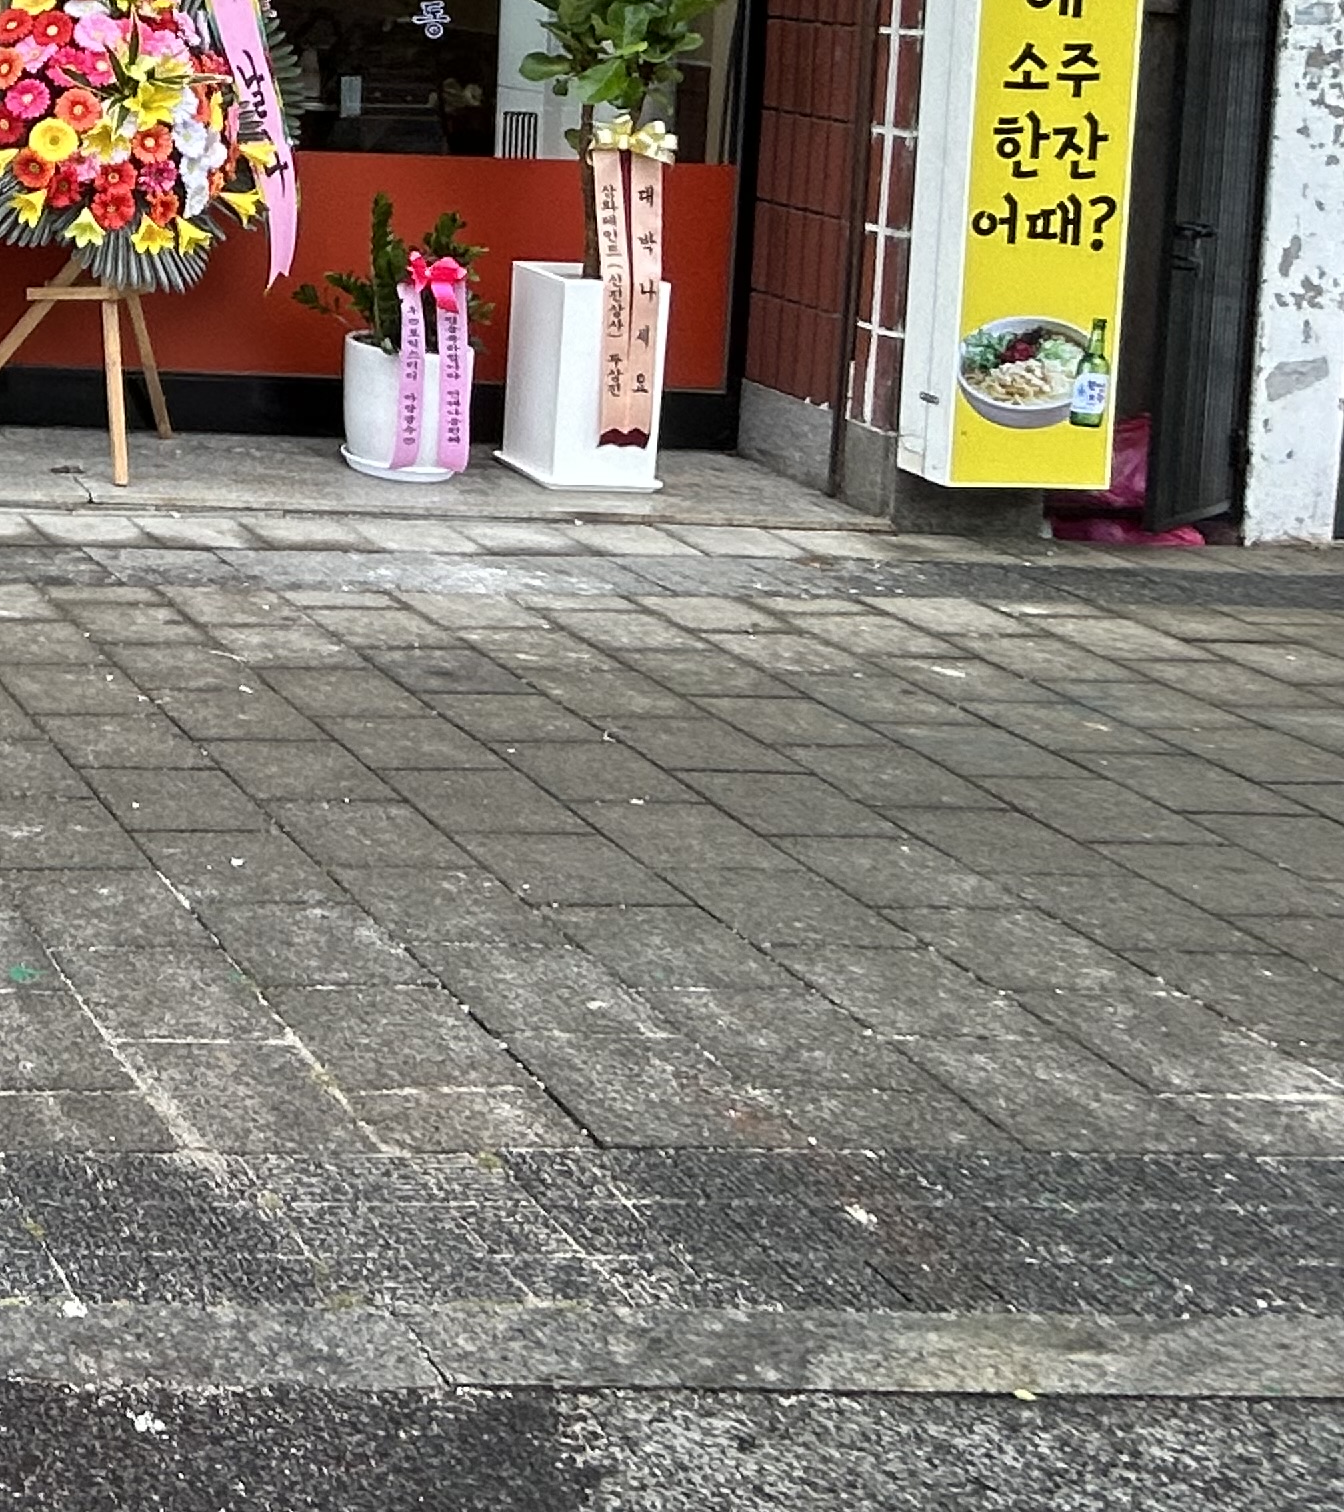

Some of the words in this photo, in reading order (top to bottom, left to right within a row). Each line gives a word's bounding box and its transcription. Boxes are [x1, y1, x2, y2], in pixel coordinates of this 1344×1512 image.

[1003, 41, 1101, 98] 소주
[992, 110, 1109, 180] 한잔
[971, 192, 1118, 252] 어때?
